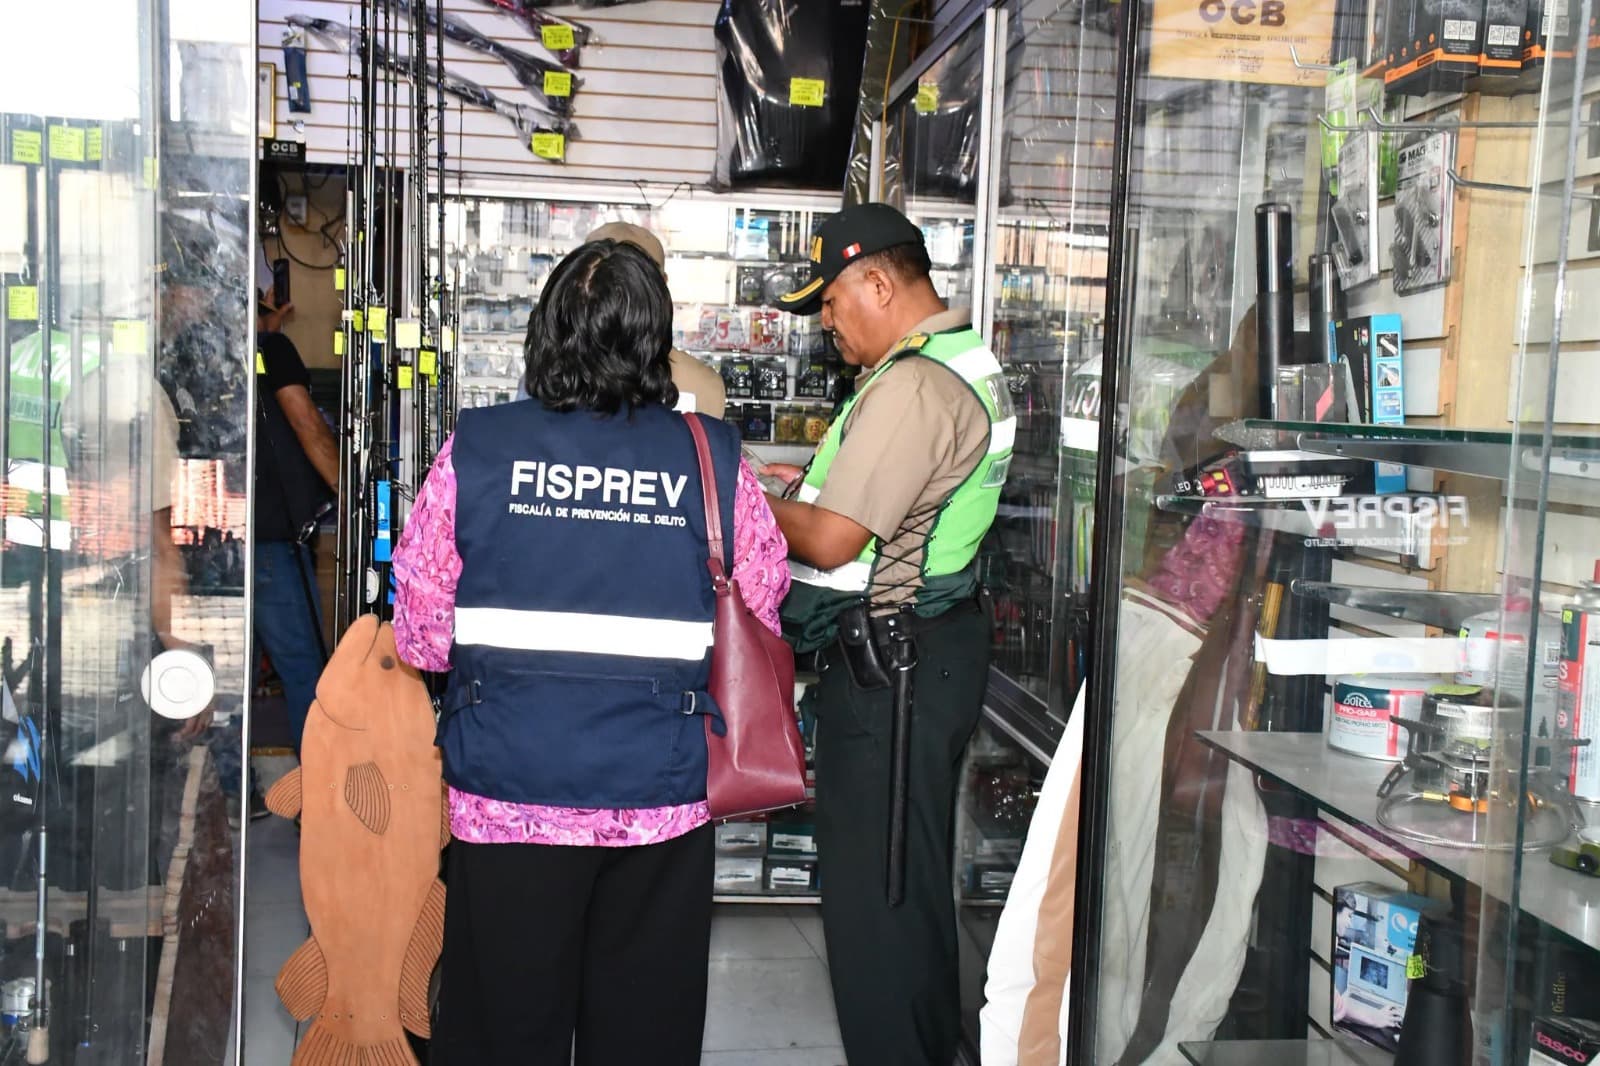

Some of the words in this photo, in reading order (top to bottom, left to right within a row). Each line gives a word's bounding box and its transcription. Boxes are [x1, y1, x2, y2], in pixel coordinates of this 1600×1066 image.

[1199, 0, 1286, 26] OCB
[271, 142, 298, 153] OCB
[510, 460, 688, 508] FISPREV
[509, 502, 552, 517] FISCALÍA
[555, 507, 569, 518] DE
[571, 508, 631, 523] PREVENCIÓN
[633, 514, 651, 524] DEL
[654, 514, 687, 528] DELITO
[1536, 1031, 1588, 1063] tasco
